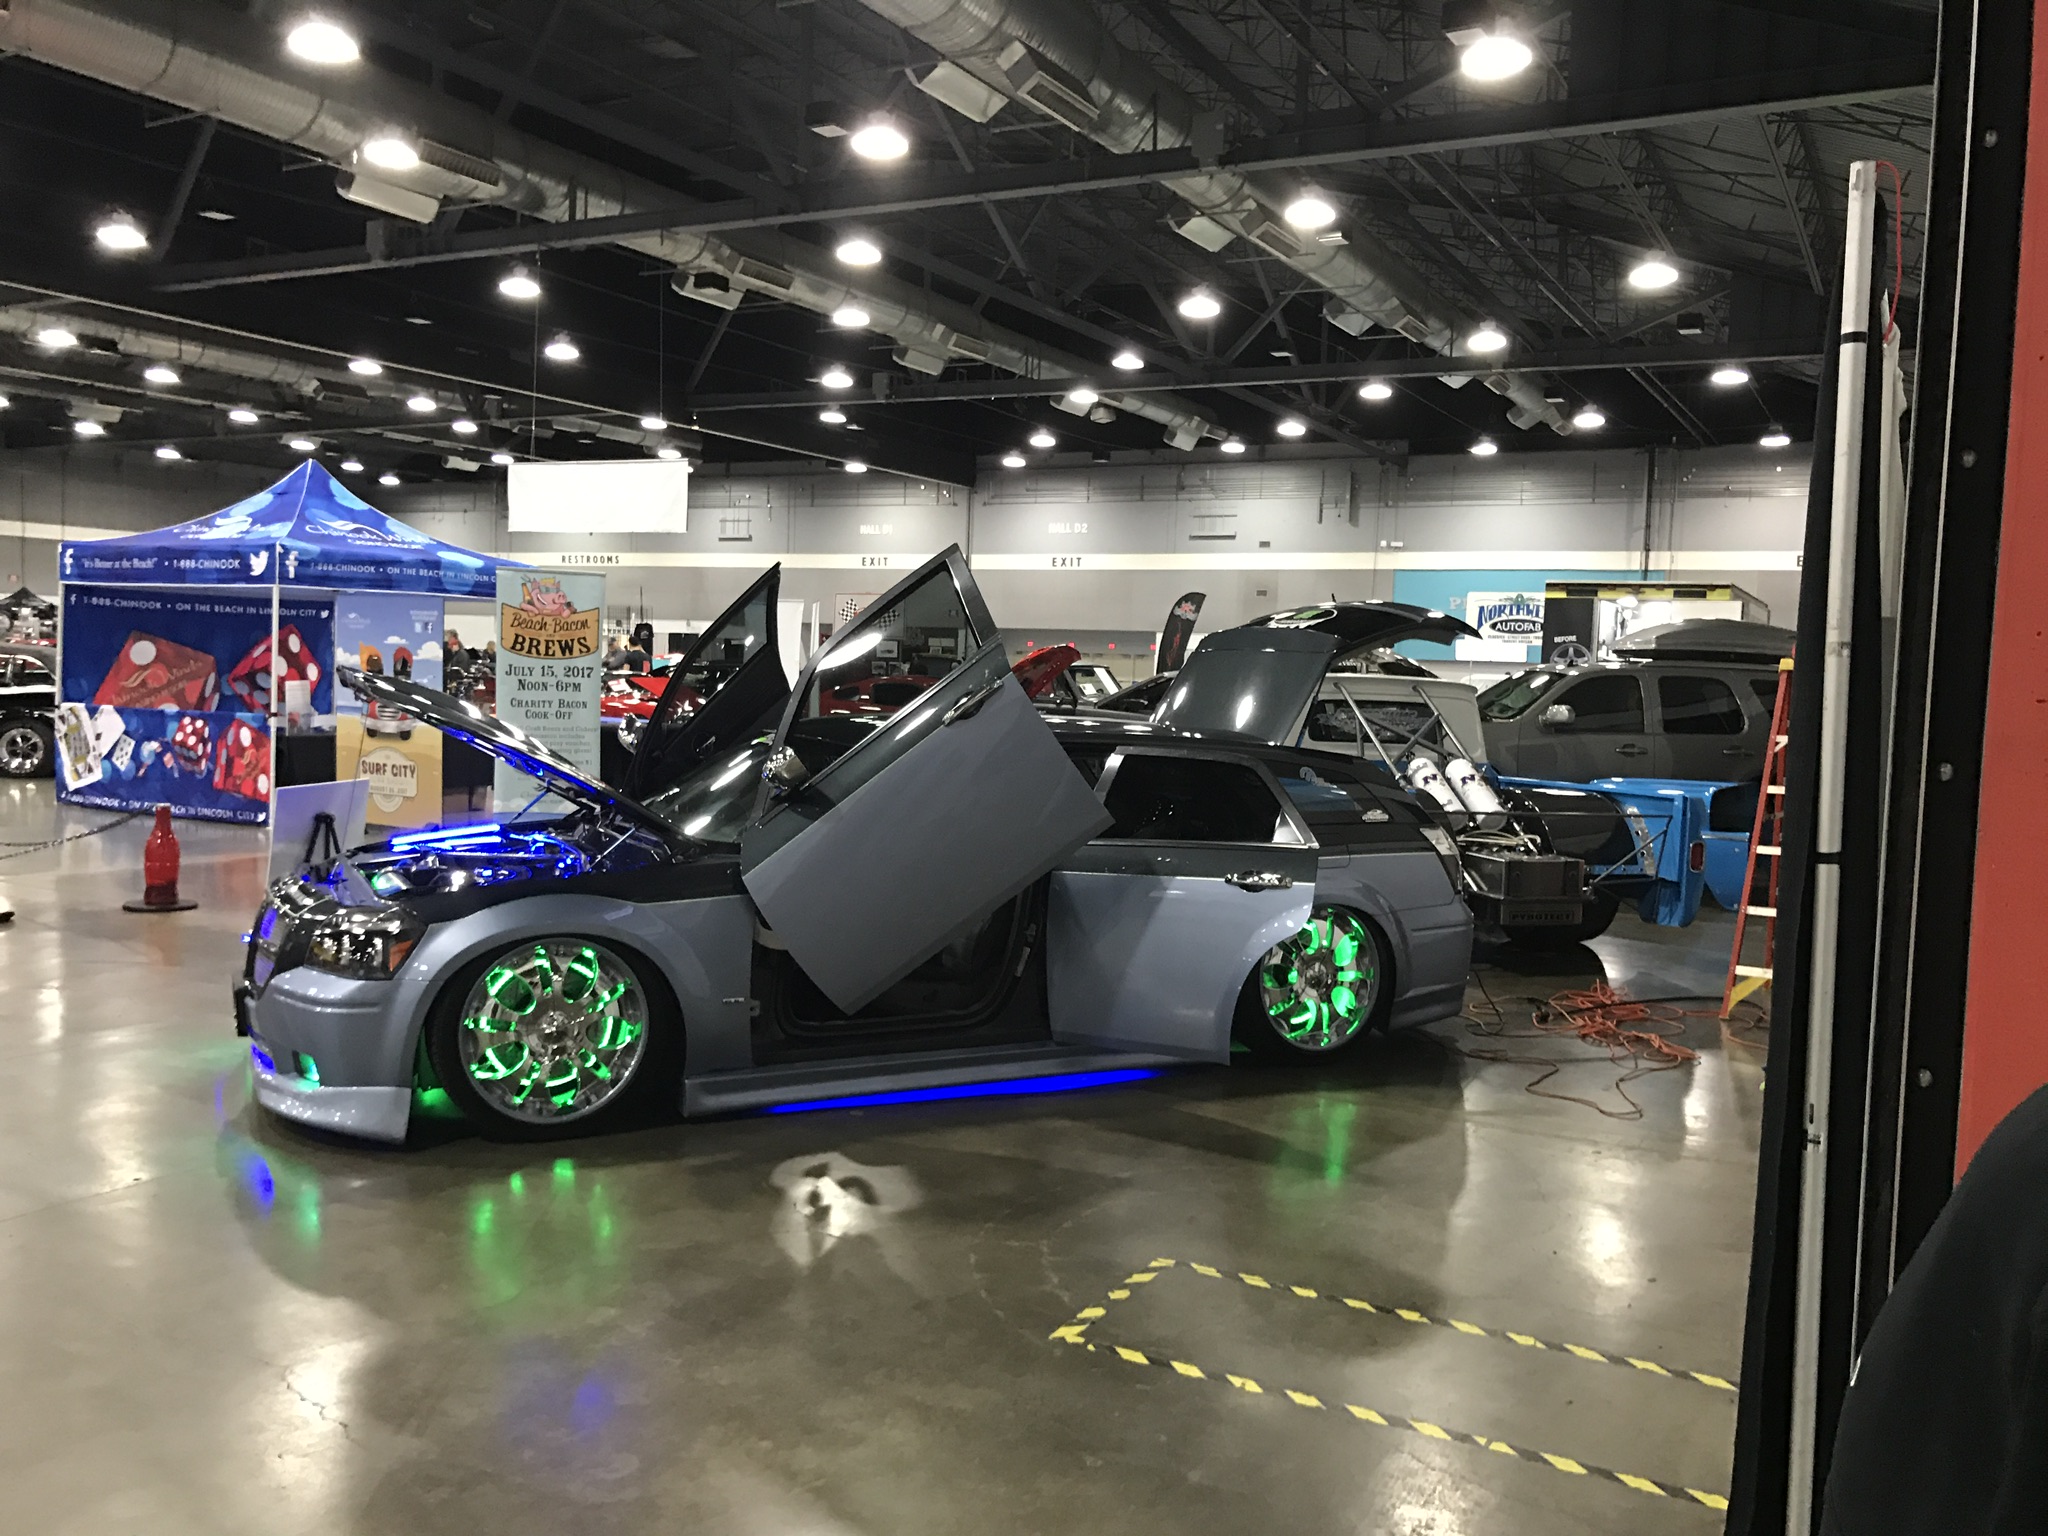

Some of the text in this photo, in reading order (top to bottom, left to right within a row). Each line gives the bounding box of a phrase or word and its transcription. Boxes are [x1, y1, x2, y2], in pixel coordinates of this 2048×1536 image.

[859, 524, 881, 535] HALL
[1048, 522, 1088, 534] HALL D2
[561, 555, 620, 565] RESTROOMS
[861, 556, 888, 567] EXIT
[1051, 557, 1082, 568] EXIT
[386, 566, 401, 574] ON
[403, 567, 417, 576] THE
[419, 568, 443, 577] BEACH
[175, 602, 192, 611] ON
[194, 604, 211, 612] THE
[214, 605, 244, 614] BEACH
[259, 607, 297, 617] LINOLN
[299, 609, 317, 617] CITY
[1495, 622, 1542, 632] AUTOFAB
[1553, 635, 1577, 643] BEFORE
[510, 633, 592, 657] BREWS
[540, 665, 558, 679] 15,
[563, 666, 594, 679] 2017
[361, 760, 416, 779] SURF CITY
